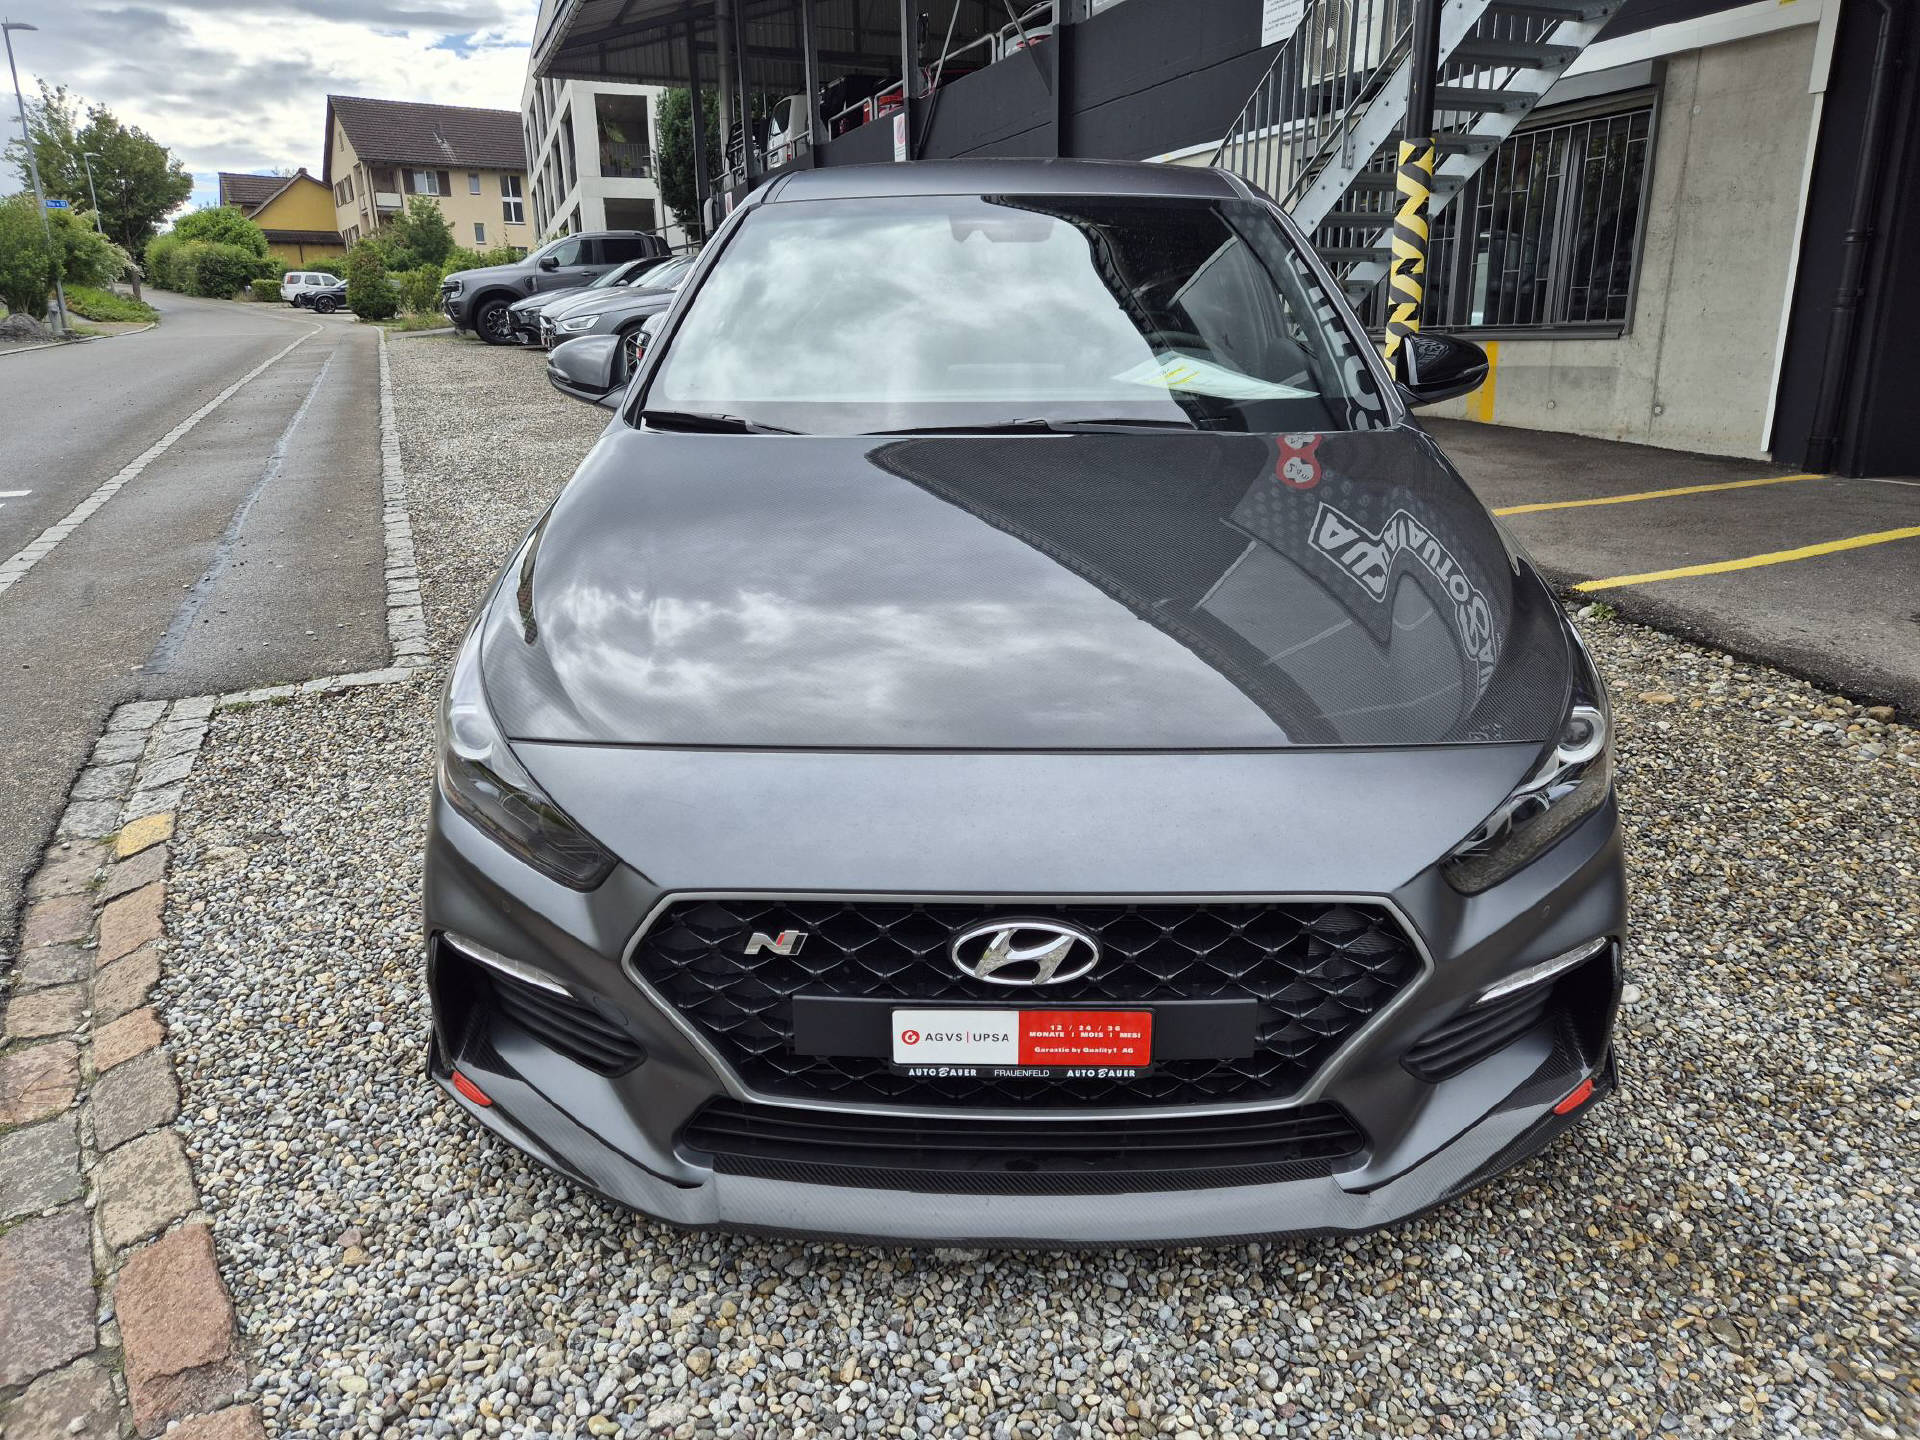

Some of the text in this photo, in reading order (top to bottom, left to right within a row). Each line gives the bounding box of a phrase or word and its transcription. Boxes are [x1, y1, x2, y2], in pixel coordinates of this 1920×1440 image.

[925, 1033, 963, 1042] AGVS
[973, 1033, 1010, 1042] UPSA
[1071, 1046, 1081, 1054] by
[908, 1067, 1136, 1078] AUTO BAUER FRAUENFELD AUTO BAUER
